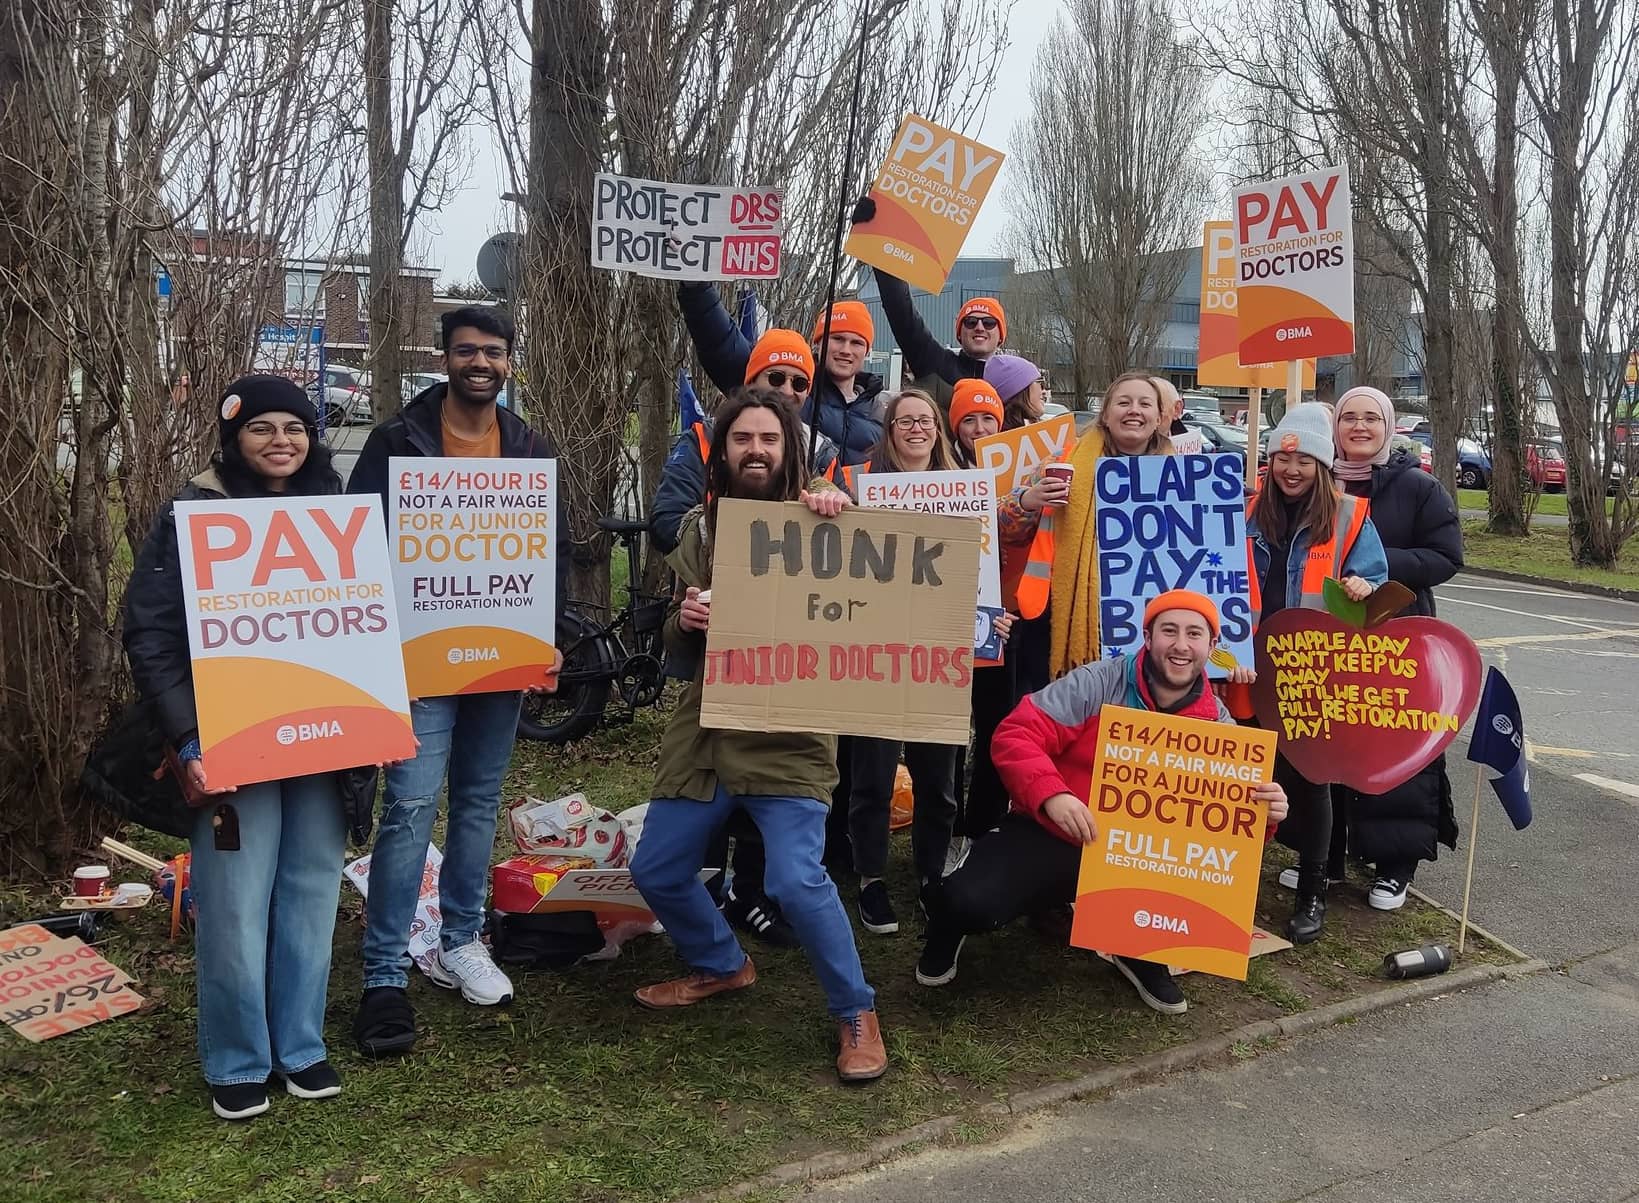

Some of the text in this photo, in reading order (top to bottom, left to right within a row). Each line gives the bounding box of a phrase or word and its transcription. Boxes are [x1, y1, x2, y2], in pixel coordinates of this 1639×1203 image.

[894, 121, 998, 192] PAY
[878, 174, 972, 226] DOCTORS
[887, 162, 977, 209] RESTORATION FOR
[597, 179, 780, 227] PROTECT DRS
[1237, 175, 1340, 245] PAY
[597, 226, 775, 272] PROTECT NHS
[894, 247, 915, 265] BMA
[1240, 231, 1343, 259] RESTORATION FOR
[1241, 245, 1344, 282] DOCTORS
[1288, 326, 1313, 339] BMA
[781, 351, 804, 363] BMA
[984, 396, 1000, 408] BMA
[400, 470, 548, 490] £14/HOUR IS
[866, 481, 988, 501] £14/HOUR IS
[1096, 454, 1243, 504] CLAPS
[399, 494, 547, 509] NOT A FAIR WAGE
[915, 502, 945, 513] FAIR
[949, 500, 989, 511] WAGE
[399, 512, 547, 532] FOR A JUNIOR
[1098, 503, 1244, 550] DON'T
[188, 506, 371, 591] PAY
[399, 533, 548, 563] DOCTOR
[750, 518, 944, 586] HONK
[413, 574, 534, 598] FULL PAY
[1100, 548, 1248, 597] PAY THE
[198, 583, 384, 612] RESTORATION FOR
[413, 597, 534, 612] RESTORATION NOW
[200, 604, 388, 649] DOCTORS
[463, 647, 500, 662] BMA
[1266, 630, 1411, 657] AN APPLE A DAY
[705, 642, 971, 688] JUNIOR DOCTORS
[1275, 668, 1330, 688] AWAY
[1334, 653, 1386, 674] KEEP
[1389, 658, 1418, 679] US
[1276, 684, 1409, 706] UNTIL WE GET
[298, 720, 344, 741] BMA
[1278, 700, 1458, 733] FULL RESTORATION
[1282, 718, 1332, 741] PAY!
[1108, 721, 1265, 763] £14/HOUR IS
[1104, 743, 1263, 784] NOT A FAIR WAGE
[1102, 763, 1258, 806] FOR A JUNIOR
[1098, 784, 1257, 839] DOCTOR
[1107, 828, 1238, 872] FULL PAY
[1105, 853, 1234, 886] RESTORATION NOW
[1152, 914, 1190, 935] BMA
[4, 1005, 48, 1025] OFF
